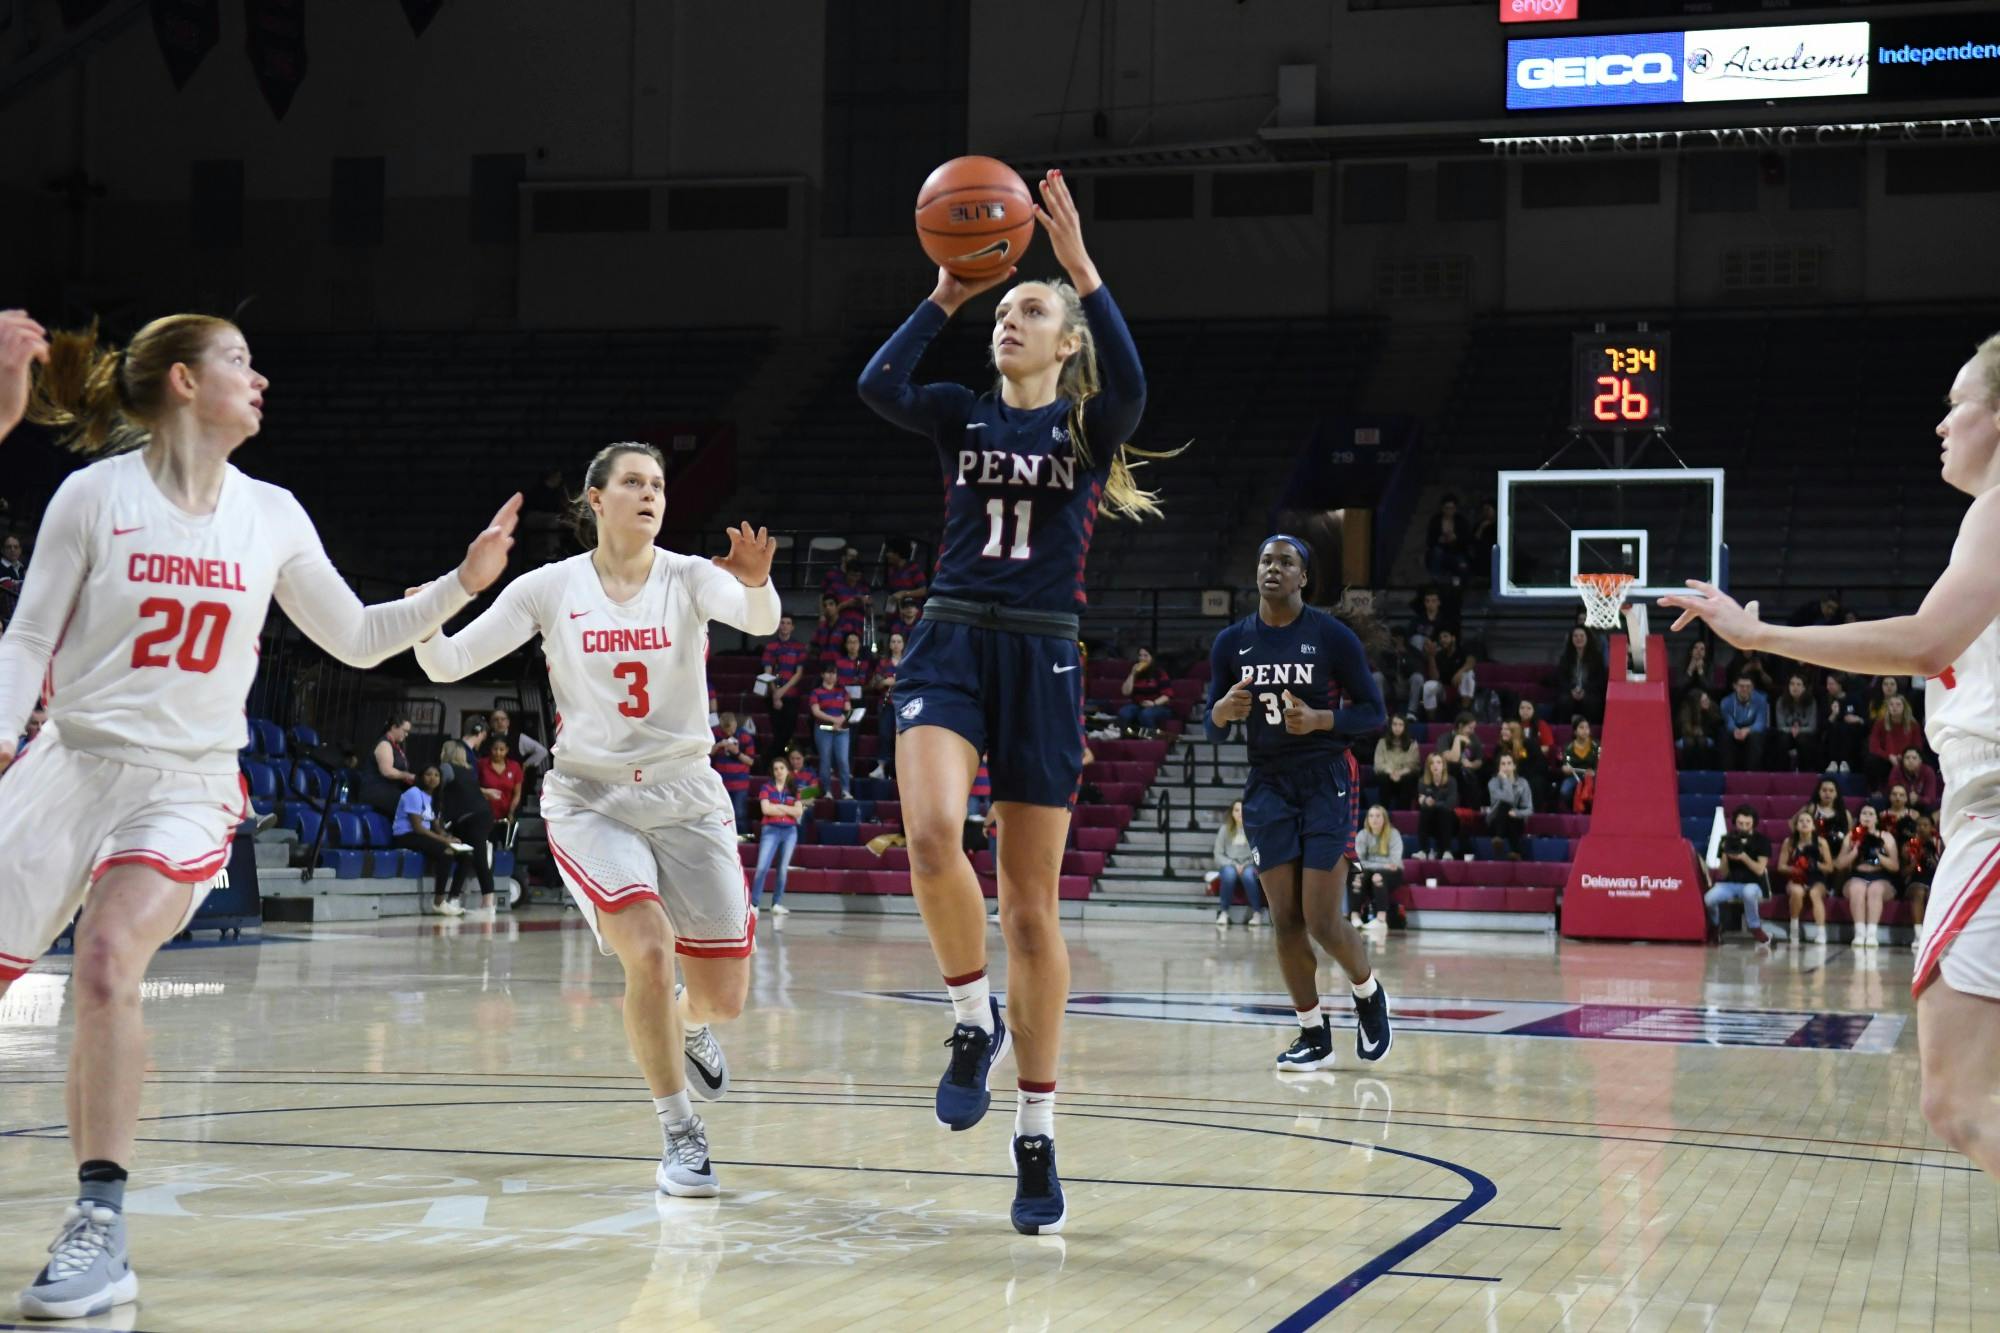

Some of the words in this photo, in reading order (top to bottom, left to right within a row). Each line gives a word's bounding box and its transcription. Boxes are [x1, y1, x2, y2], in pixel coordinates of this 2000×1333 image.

[1516, 52, 1678, 89] GEICO
[1723, 42, 1865, 78] Academy
[1493, 135, 1599, 157] HENRY
[1709, 127, 1798, 149] YANG
[951, 202, 1005, 221] ELITE
[1604, 347, 1656, 374] 7:34
[1594, 376, 1649, 420] 26
[955, 450, 1078, 490] PENN
[981, 498, 1033, 559] 11
[127, 552, 247, 592] CORNELL
[130, 597, 232, 674] 20
[582, 626, 672, 653] CORNELL
[612, 661, 650, 719] 3
[1241, 663, 1315, 685] PENN
[634, 769, 643, 782] C
[1581, 874, 1637, 888] Delaware
